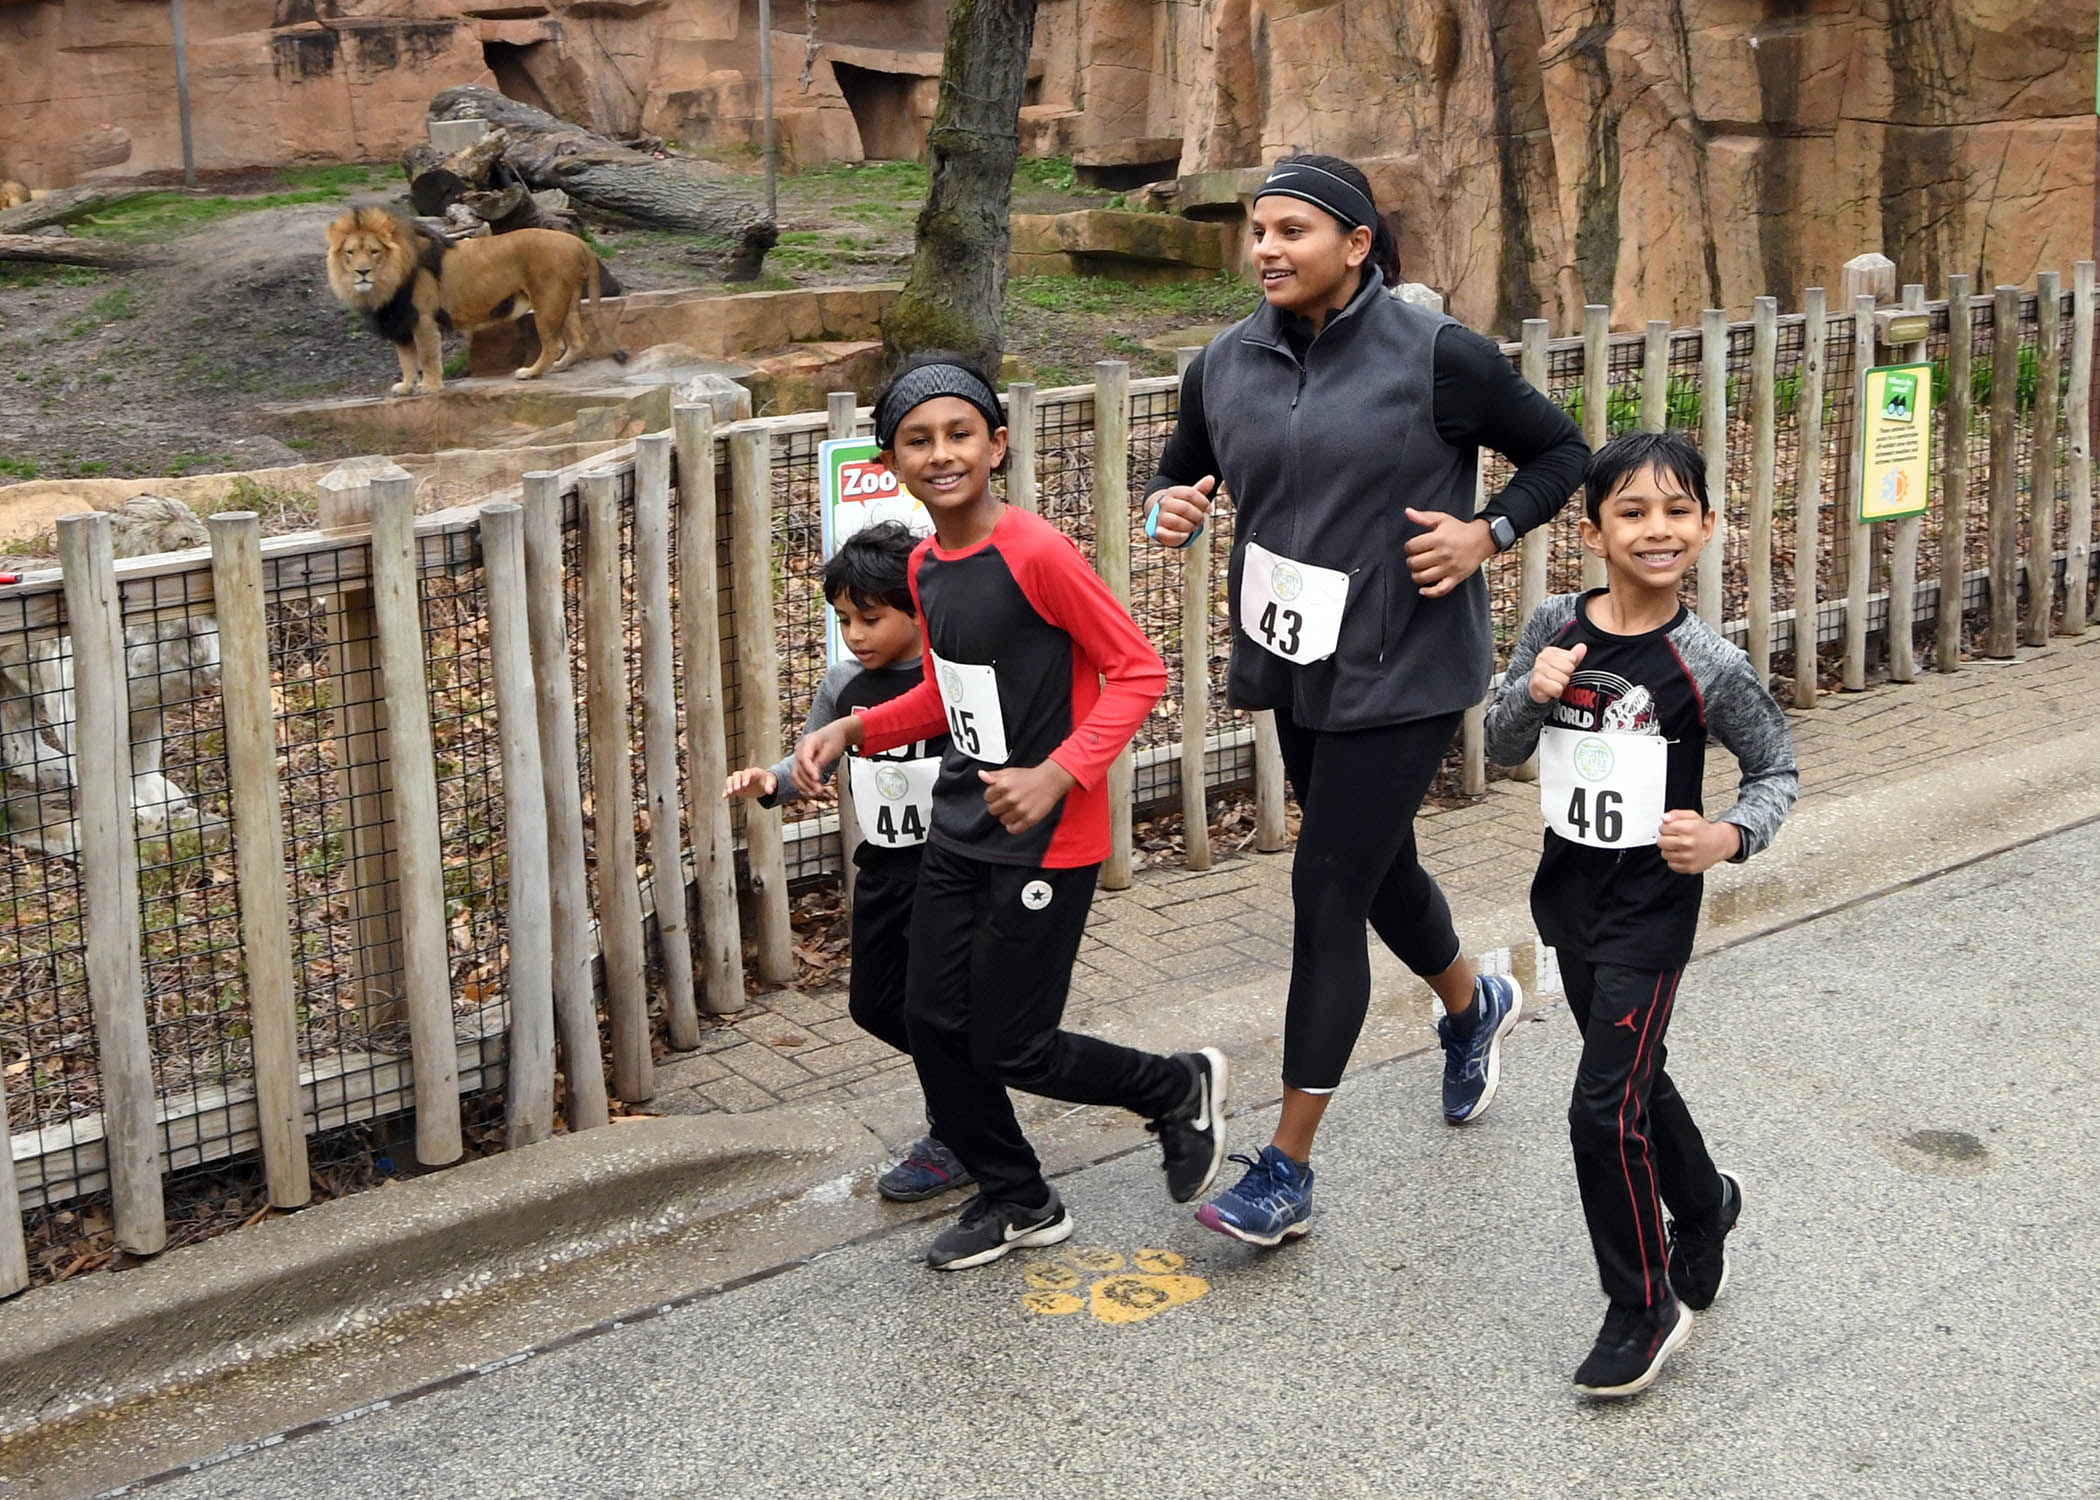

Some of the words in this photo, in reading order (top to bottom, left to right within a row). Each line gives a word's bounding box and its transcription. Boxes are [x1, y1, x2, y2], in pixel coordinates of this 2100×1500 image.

[843, 468, 897, 496] Zoo
[1260, 601, 1302, 655] 43
[950, 706, 980, 755] 45
[877, 804, 926, 843] 44
[1567, 786, 1623, 843] 46
